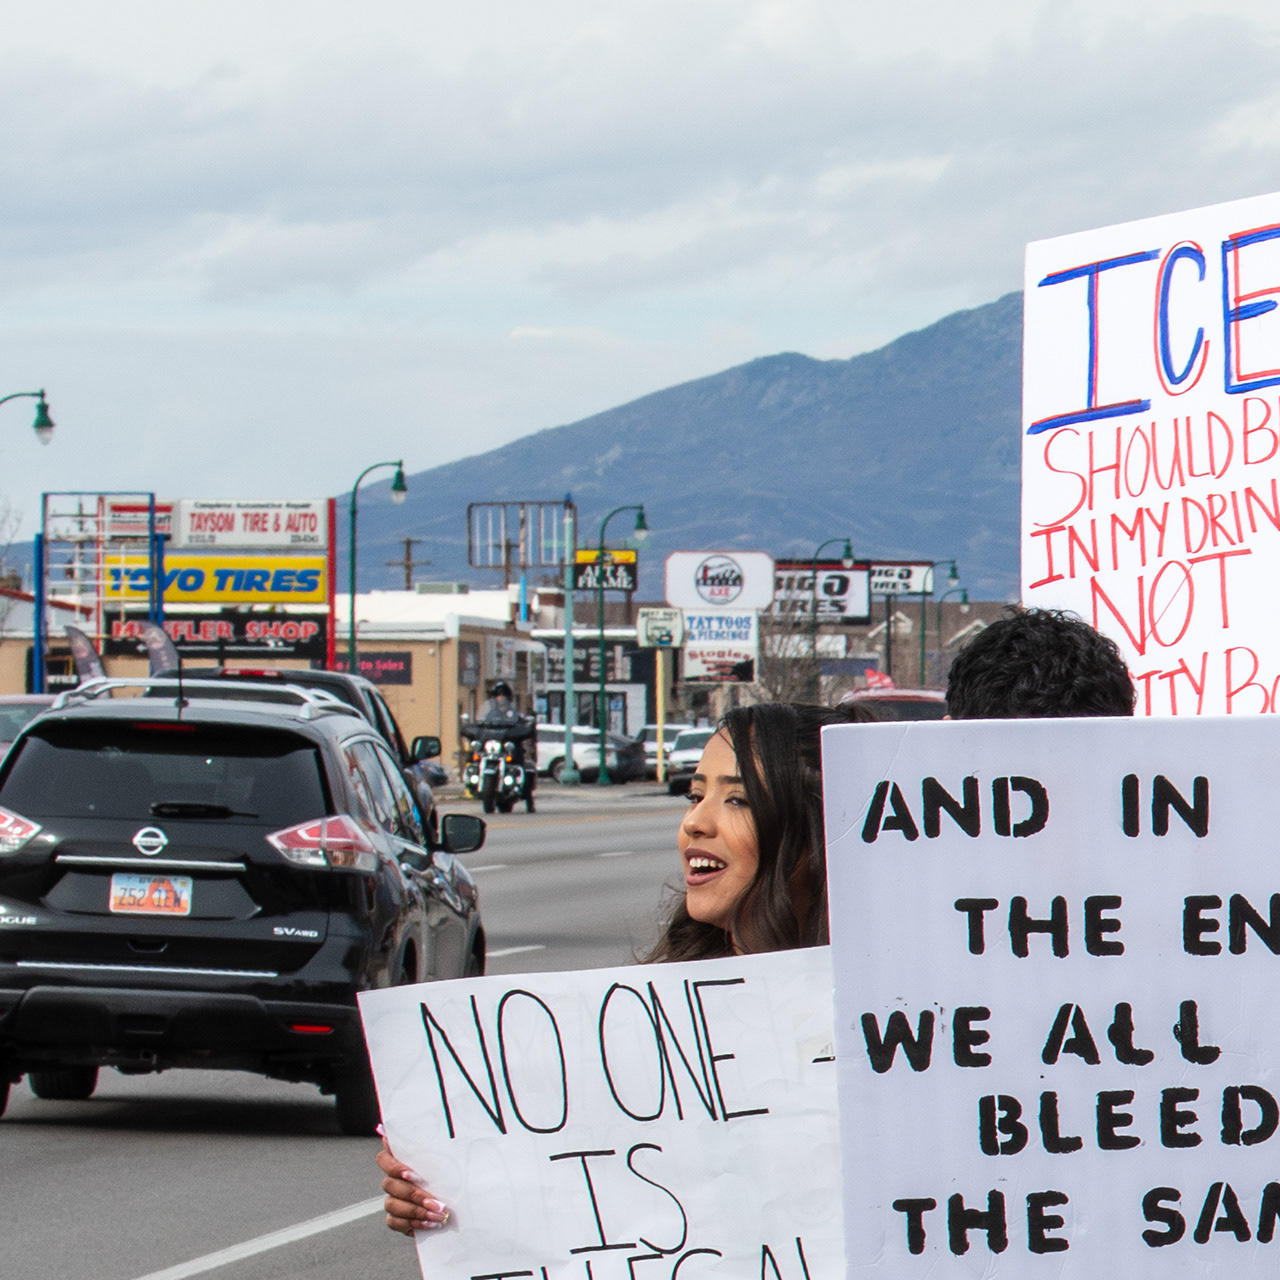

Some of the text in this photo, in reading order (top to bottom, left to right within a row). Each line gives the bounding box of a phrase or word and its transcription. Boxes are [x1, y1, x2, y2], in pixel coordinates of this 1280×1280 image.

[1033, 410, 1234, 528] SHOULD
[242, 512, 269, 533] TIRE
[285, 512, 318, 533] AUTO
[1028, 518, 1100, 589] IN
[1110, 501, 1170, 571] MY
[214, 568, 322, 592] TIRES
[1090, 549, 1252, 656] NOT
[245, 621, 318, 640] SHOP
[686, 616, 752, 629] TATTOOS
[860, 773, 1210, 844] AND IN
[954, 895, 1125, 958] THE
[421, 979, 770, 1140] NO ONE
[860, 999, 1222, 1074] WE ALL
[978, 1084, 1280, 1157] BLEED
[550, 1143, 688, 1256] IS
[892, 1189, 1071, 1256] THE
